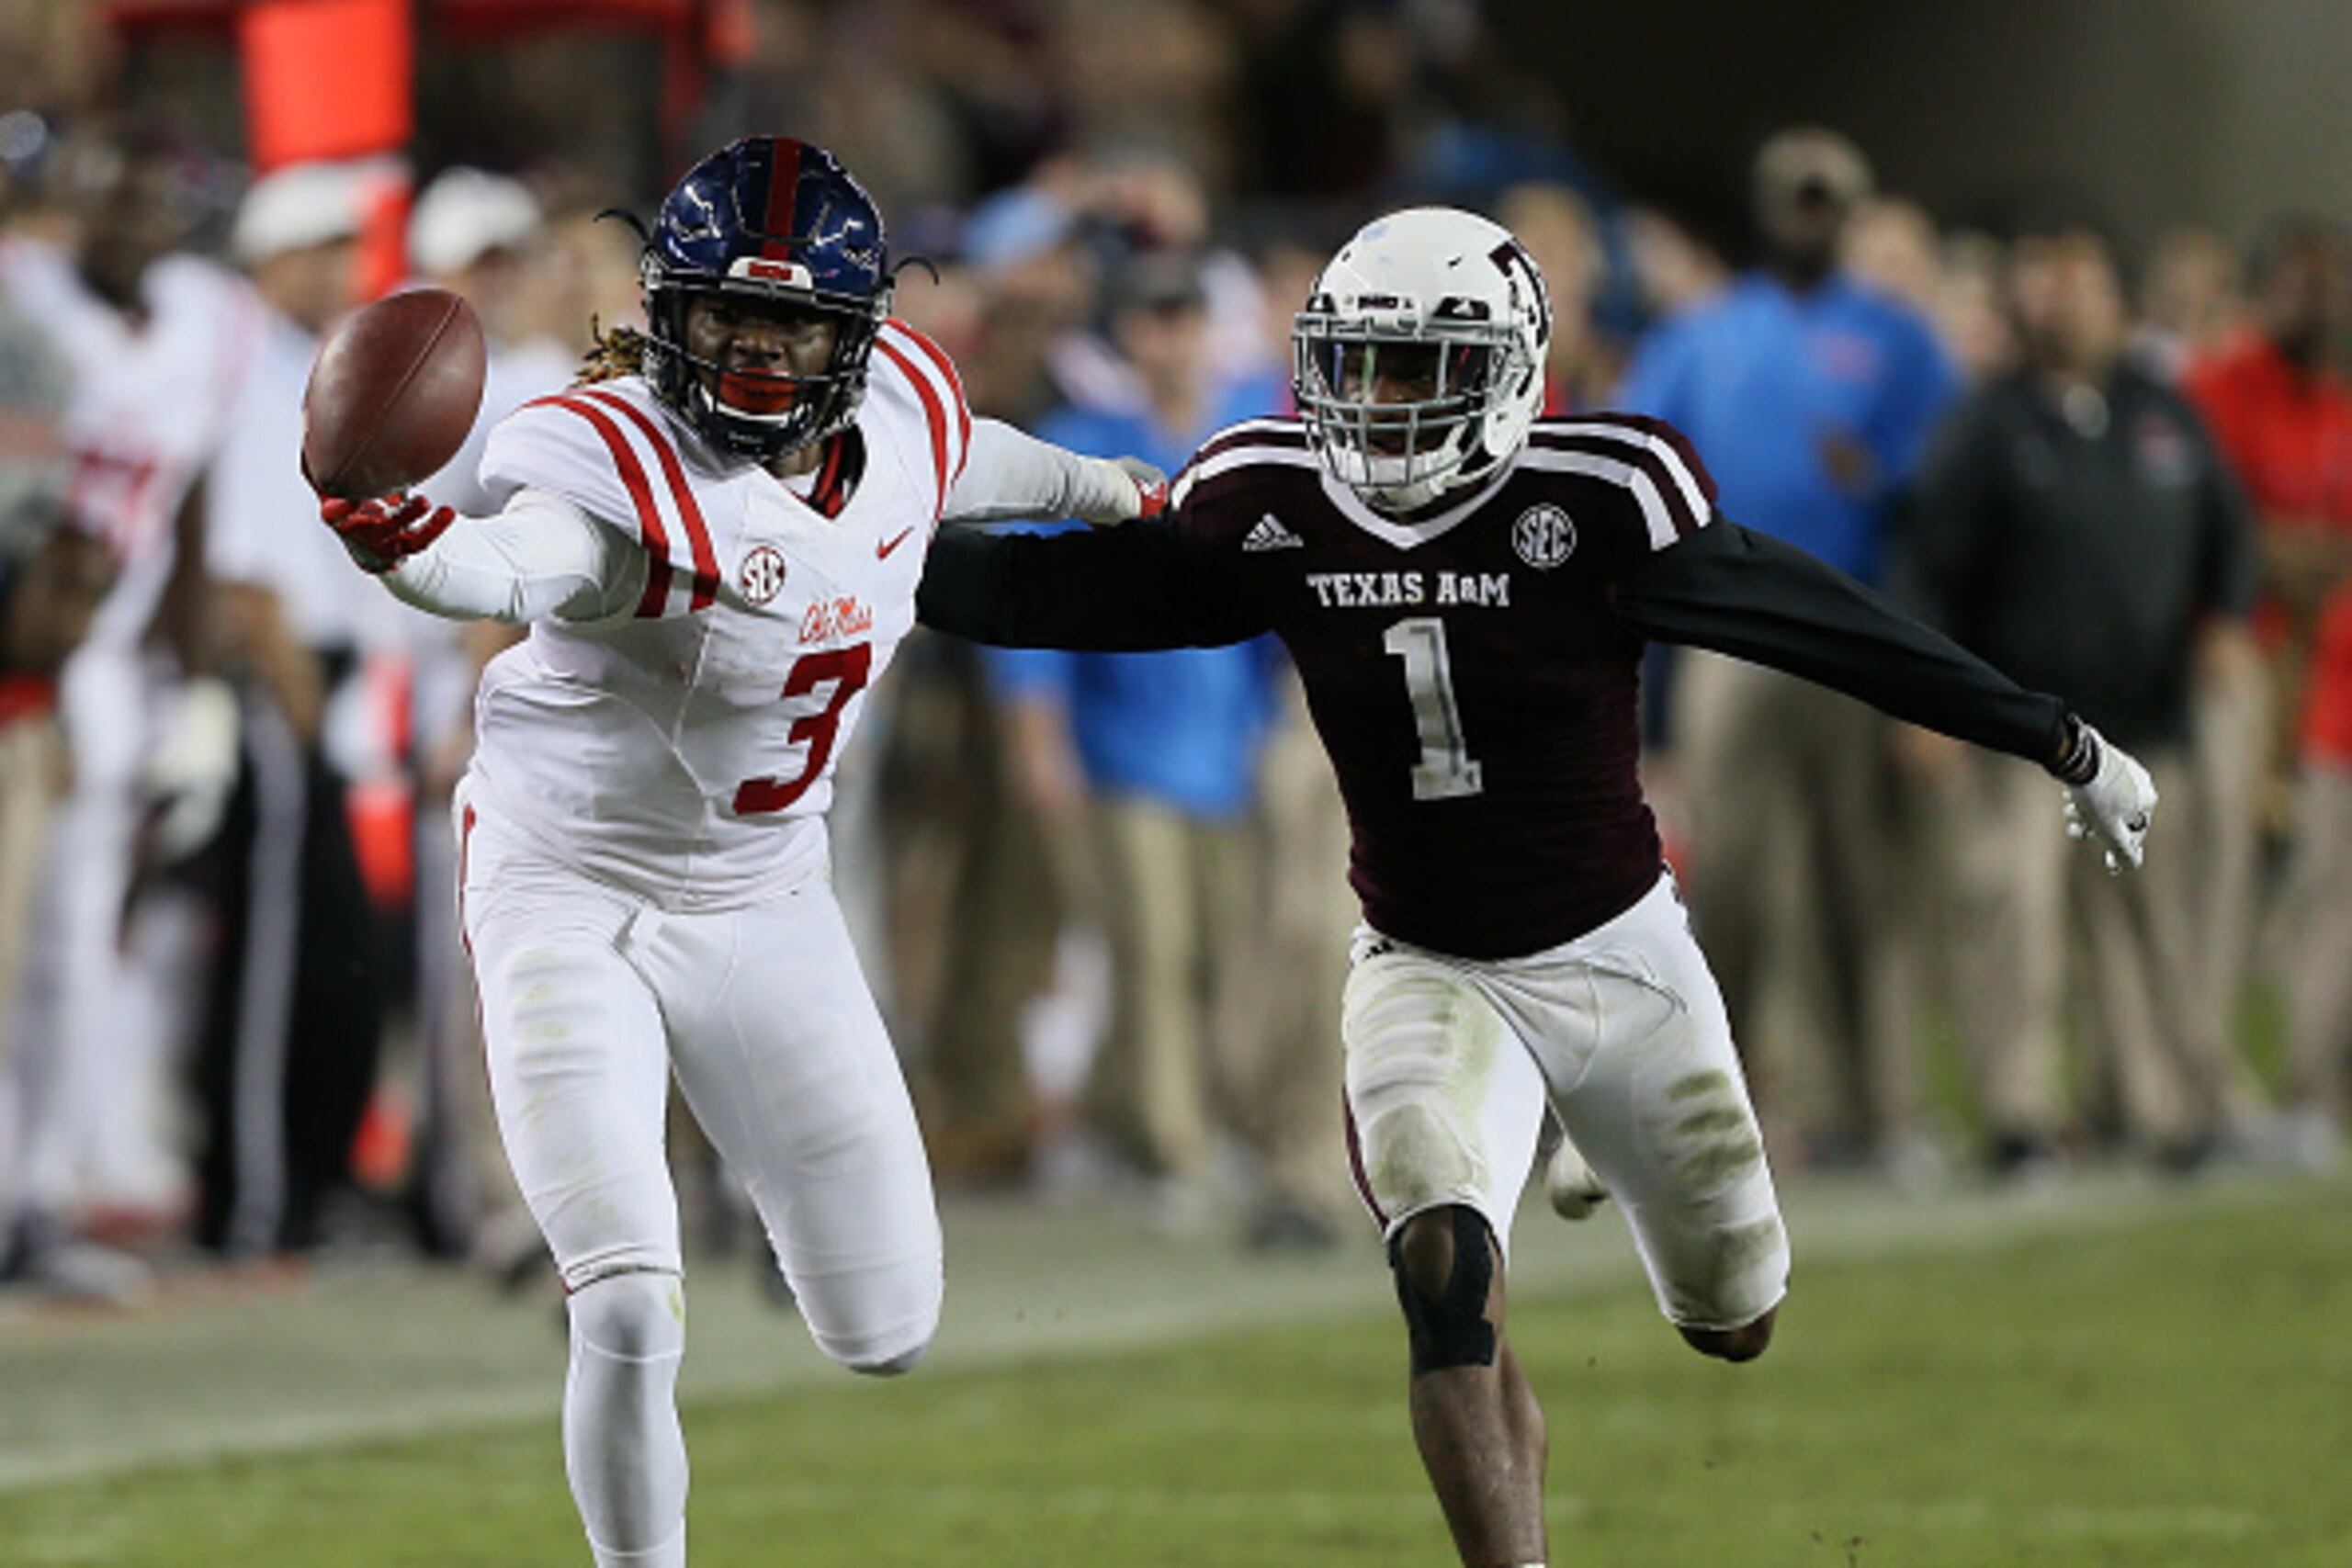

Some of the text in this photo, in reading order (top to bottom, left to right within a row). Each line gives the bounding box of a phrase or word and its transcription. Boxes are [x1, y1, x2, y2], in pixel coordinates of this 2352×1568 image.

[1519, 511, 1568, 559] SEC
[743, 553, 784, 599] SEC
[1306, 571, 1510, 607] TEXAS A&M
[733, 641, 872, 816] 3
[1383, 617, 1483, 801] 1
